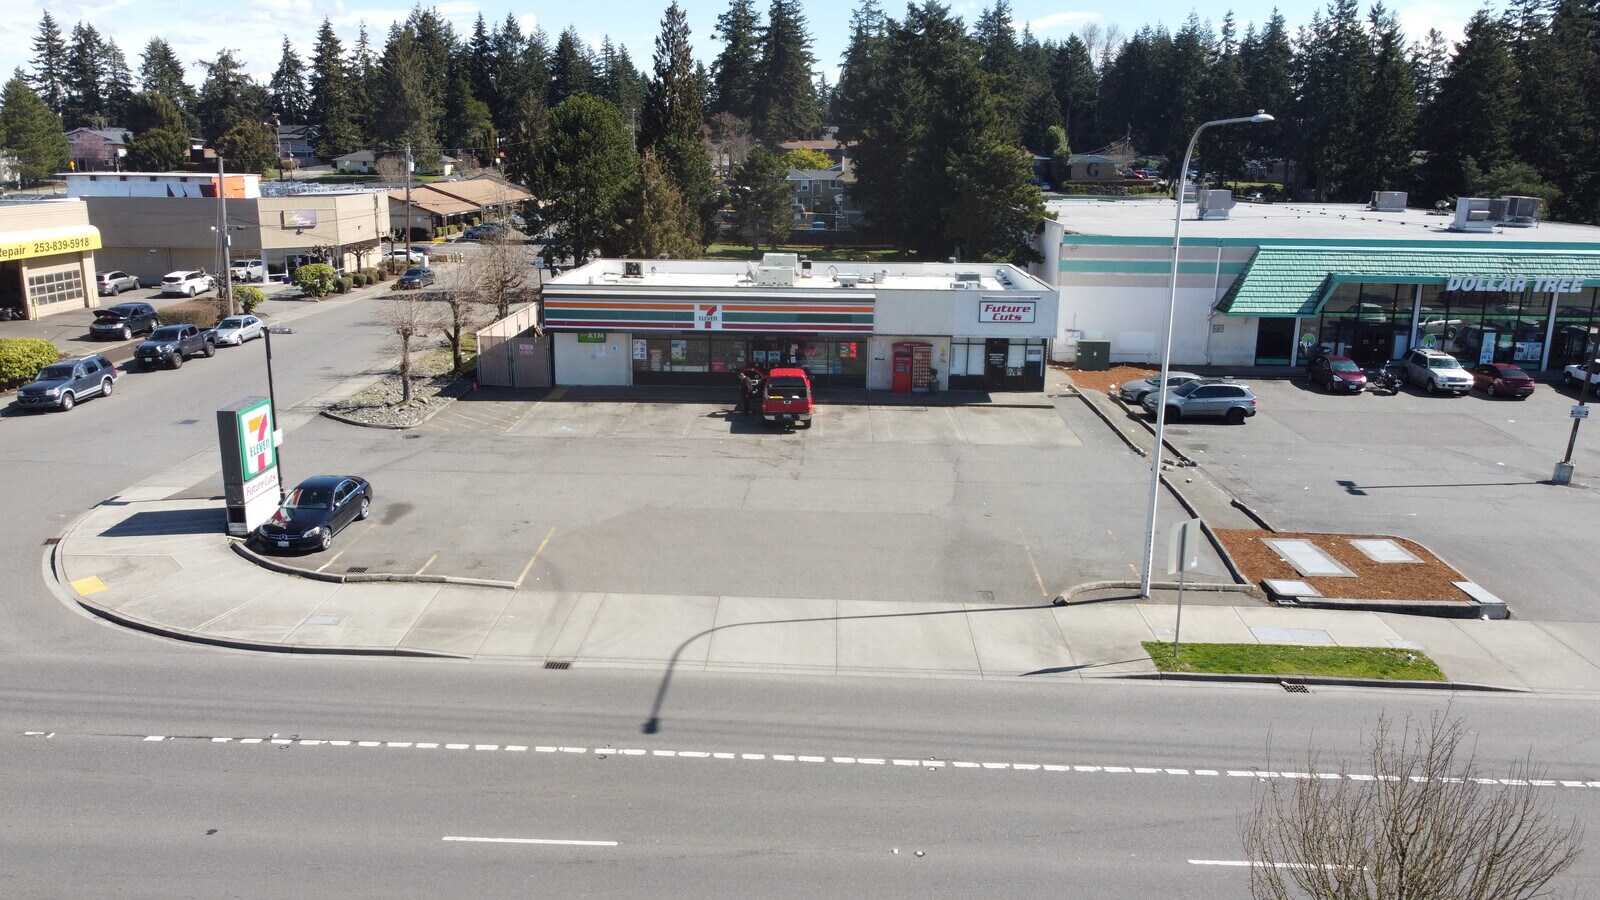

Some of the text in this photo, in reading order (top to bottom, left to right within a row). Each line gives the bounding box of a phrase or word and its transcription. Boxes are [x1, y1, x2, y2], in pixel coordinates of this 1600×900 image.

[1087, 162, 1100, 177] G
[34, 238, 89, 253] 253-839-5918
[1446, 275, 1585, 292] DOLLAR TREE
[984, 304, 1031, 313] Future
[699, 305, 717, 329] 7
[992, 313, 1022, 321] Cuts
[248, 412, 268, 472] 7
[246, 473, 276, 497] Future Cuts
